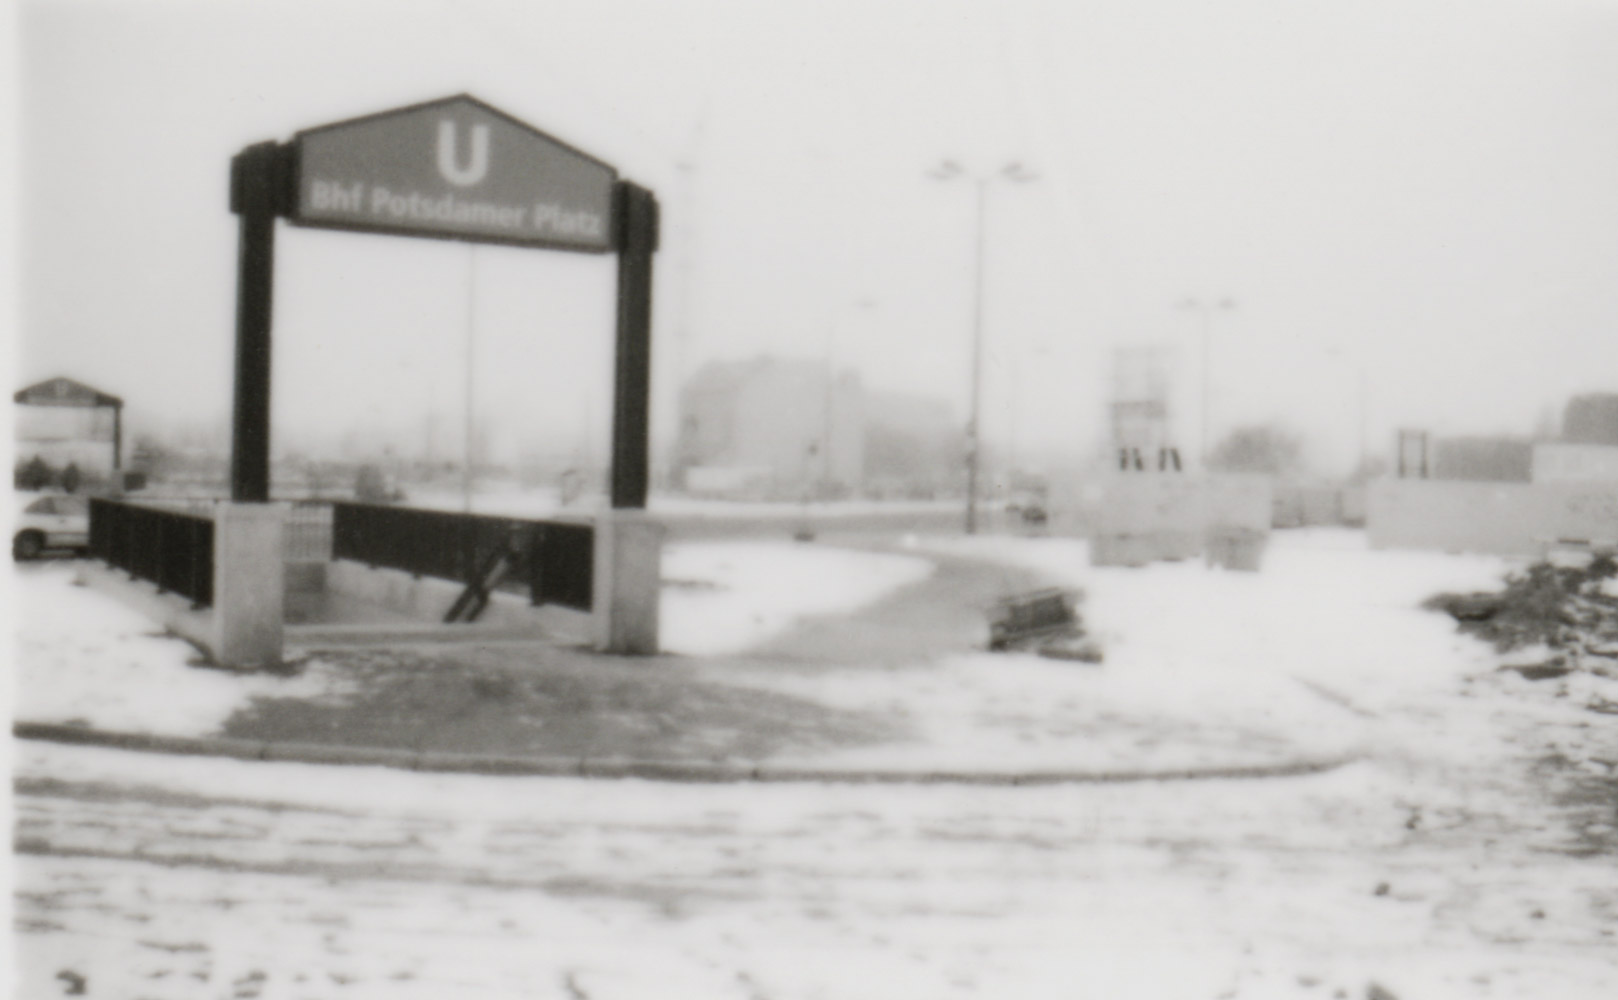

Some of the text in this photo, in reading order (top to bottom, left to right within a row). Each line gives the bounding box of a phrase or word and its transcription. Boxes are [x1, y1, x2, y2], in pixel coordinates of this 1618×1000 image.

[438, 120, 489, 186] U
[311, 181, 600, 236] Bhf Potsdamer Platz
